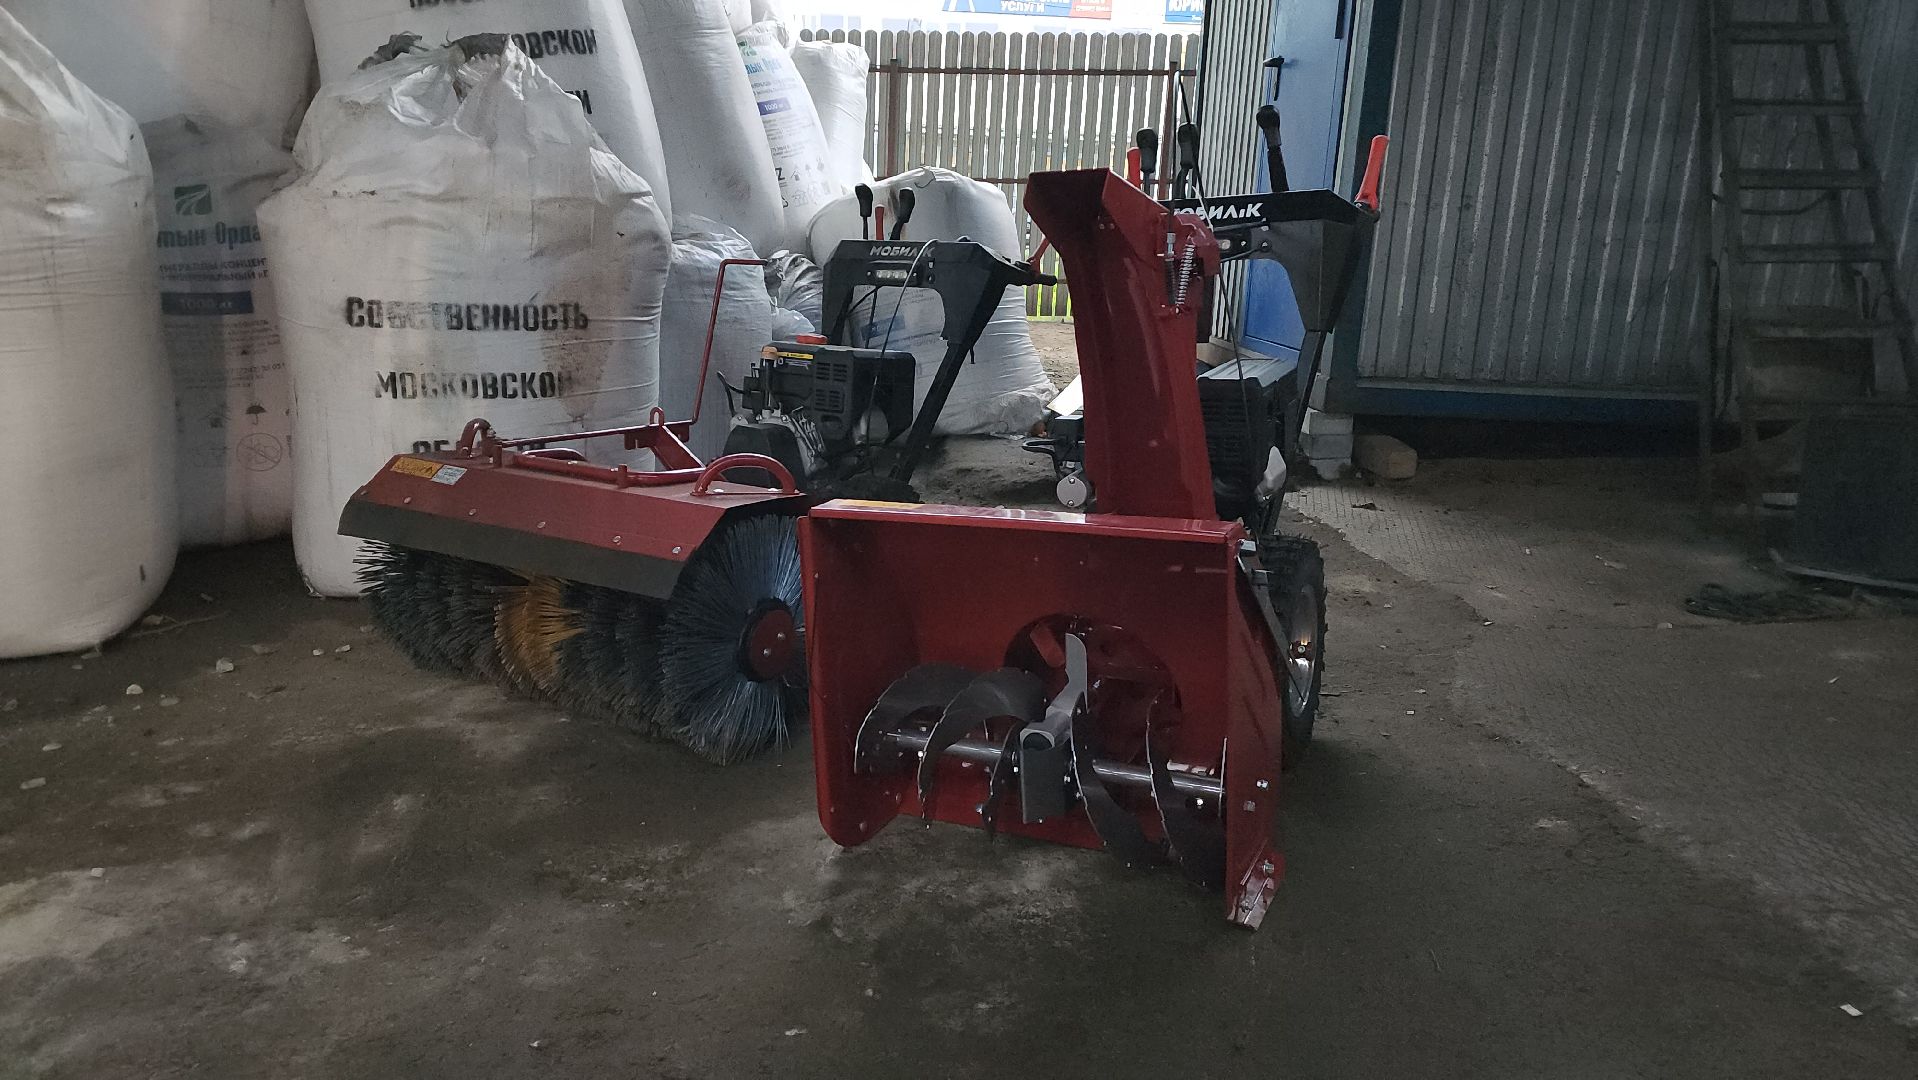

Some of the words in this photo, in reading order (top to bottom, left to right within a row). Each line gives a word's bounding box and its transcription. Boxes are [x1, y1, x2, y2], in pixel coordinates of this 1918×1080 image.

[1000, 1, 1045, 13] УСЛУГИ
[157, 229, 207, 248] тын
[223, 257, 267, 270] КОНЦЕНТ
[346, 297, 589, 332] СОБСТВЕННОСТЬ
